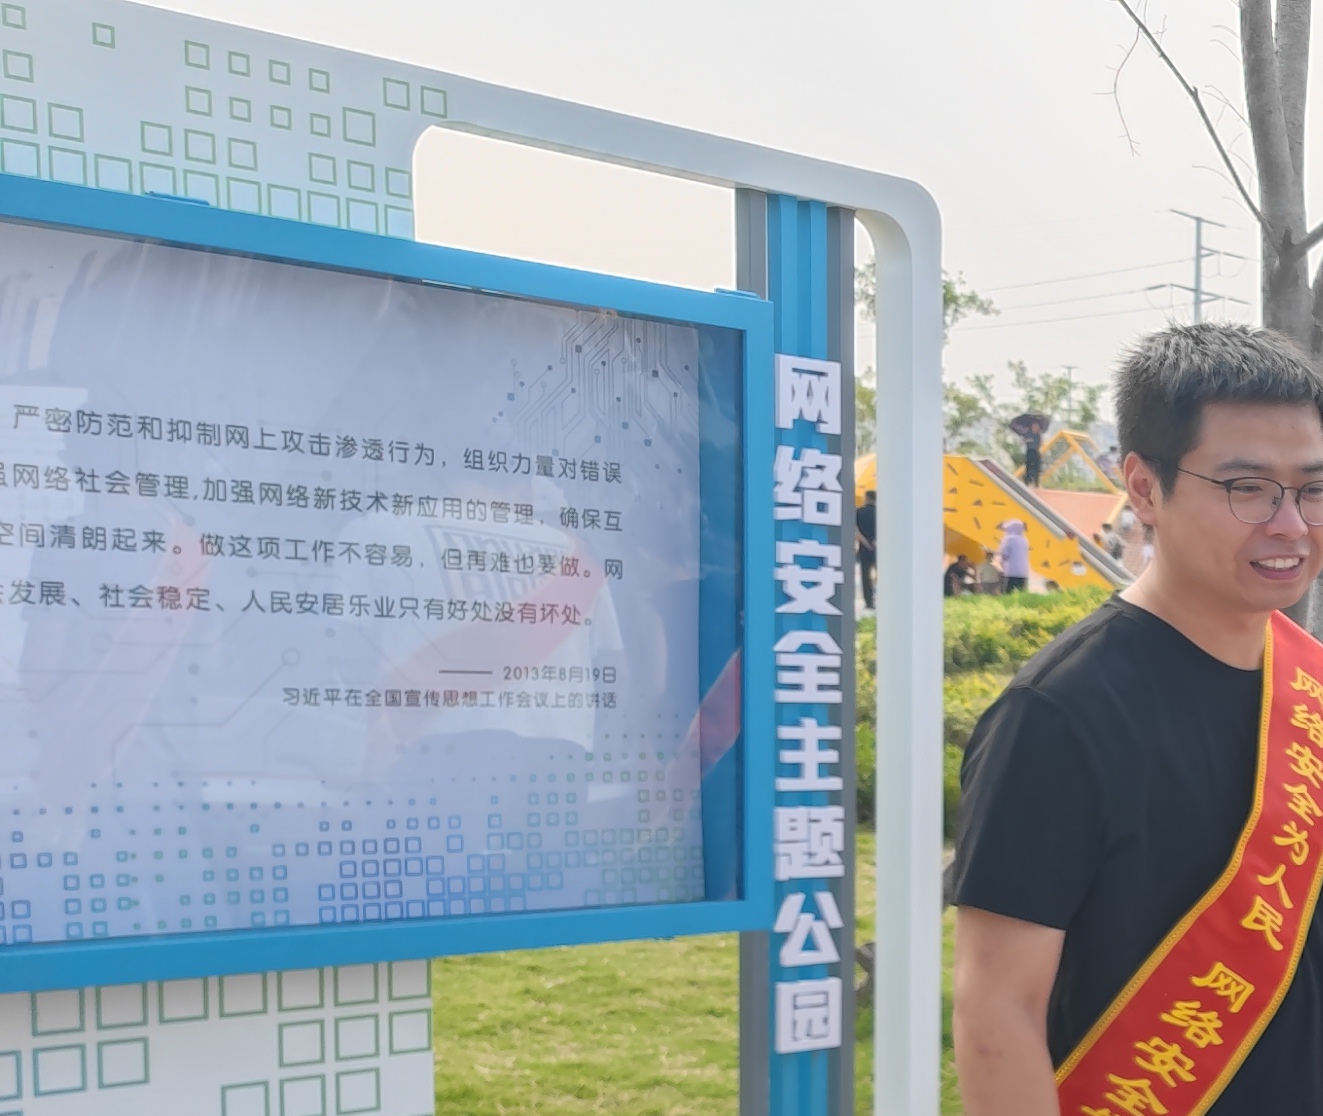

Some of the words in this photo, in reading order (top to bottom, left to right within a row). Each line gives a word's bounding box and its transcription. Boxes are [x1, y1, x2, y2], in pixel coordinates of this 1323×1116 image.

[0, 580, 593, 627] 发展、社会稳定、人民安居乐业只有好处没有坏处。
[502, 666, 617, 684] 2013年8月19日
[282, 686, 617, 710] 习近平在全国宣传思想工作会议上的讲话
[773, 353, 844, 1055] 网络安全主题公园
